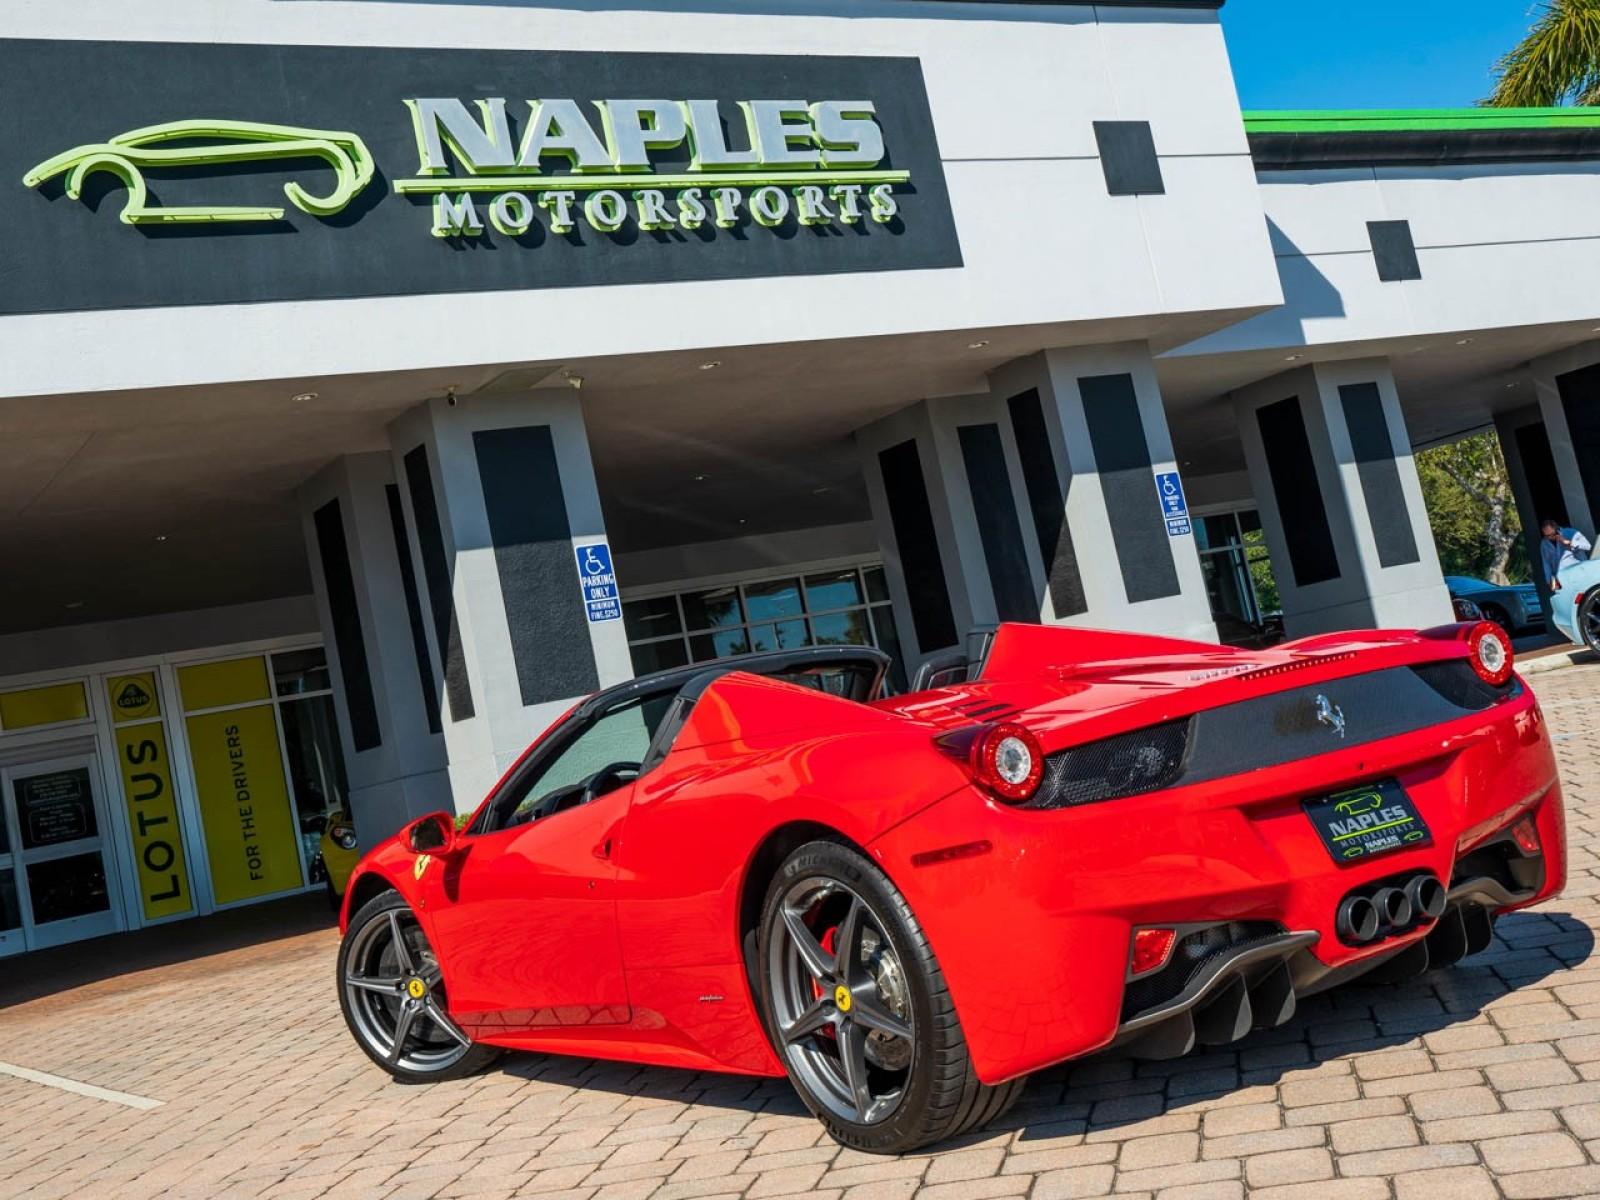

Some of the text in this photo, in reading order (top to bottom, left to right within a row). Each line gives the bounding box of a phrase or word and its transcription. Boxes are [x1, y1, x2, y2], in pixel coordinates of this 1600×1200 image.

[401, 97, 886, 176] NAPLES
[430, 183, 898, 238] MOTORSPORTS
[583, 574, 614, 587] PARKING
[591, 587, 609, 599] ONLY
[126, 739, 181, 903] LOTUS
[225, 724, 263, 881] FOR THE DRIVERS
[1328, 804, 1408, 837] NAPLES
[1340, 821, 1415, 847] MOTORSPORTS
